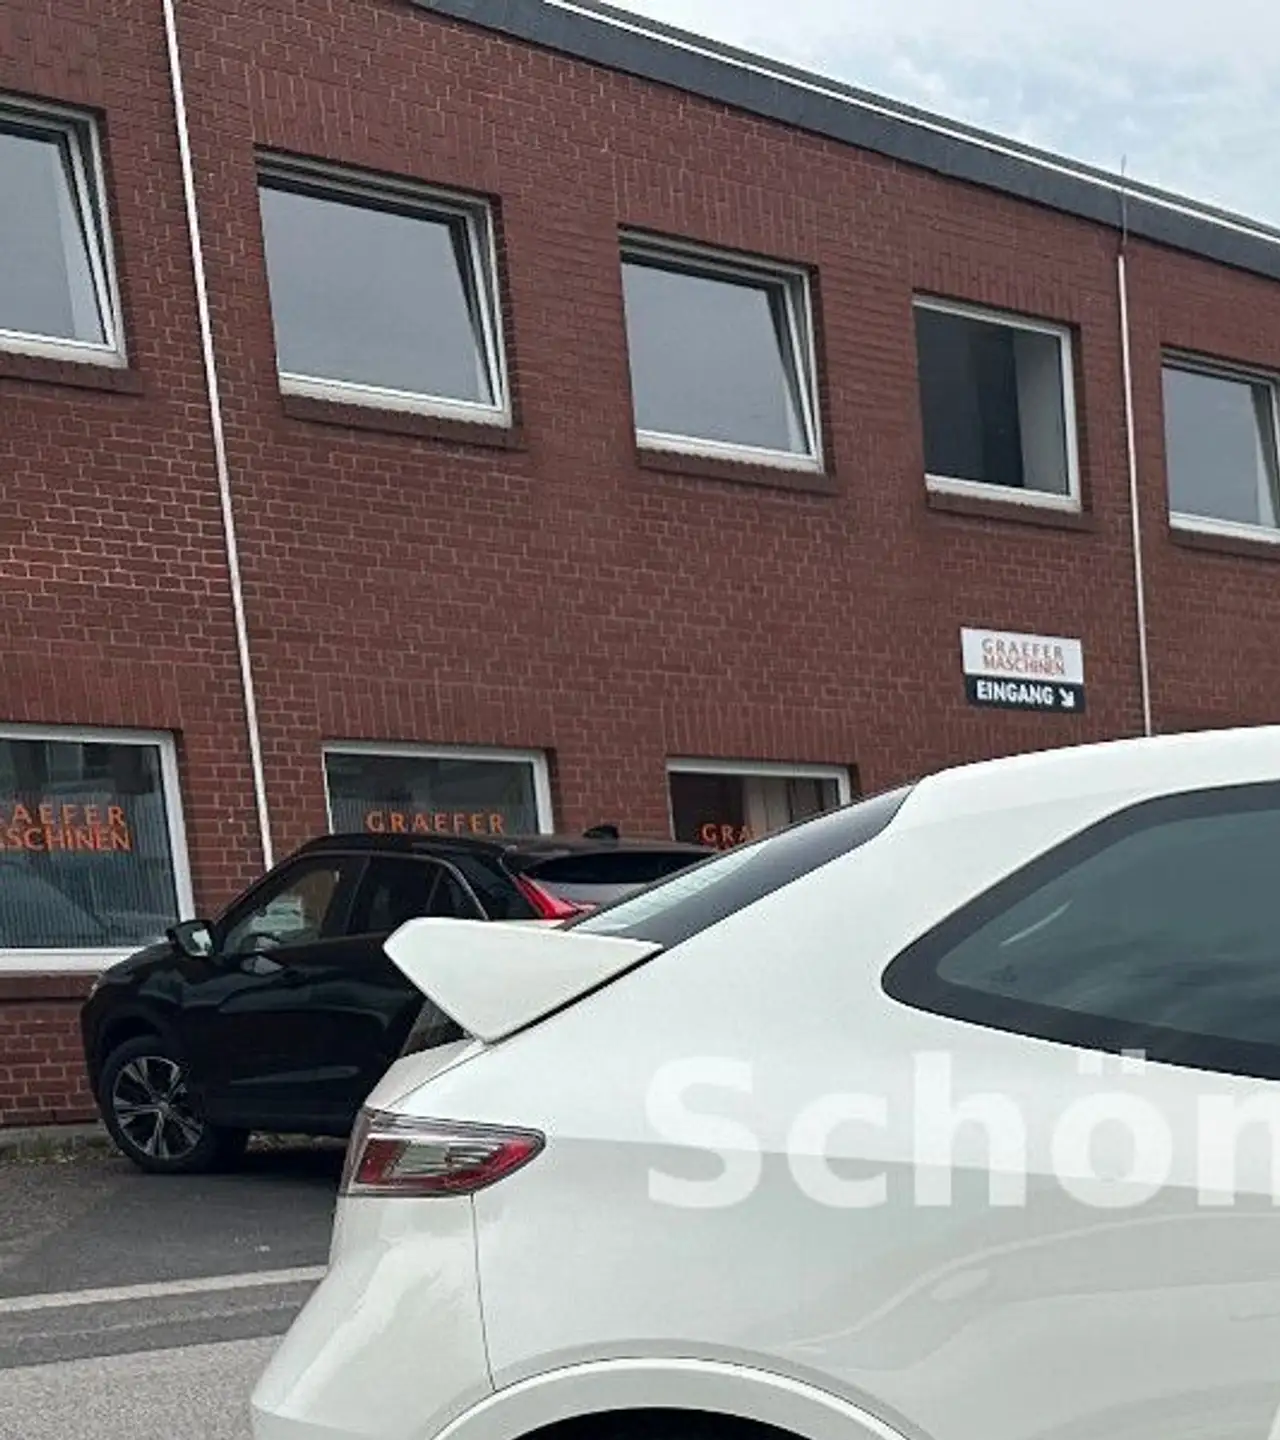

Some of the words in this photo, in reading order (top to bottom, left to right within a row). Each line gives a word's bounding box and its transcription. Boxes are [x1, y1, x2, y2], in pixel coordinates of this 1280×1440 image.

[981, 638, 1063, 657] GRAEFER
[983, 655, 1066, 676] MASCHINEN
[976, 680, 1054, 705] EINGANG
[0, 803, 126, 826] AEFER
[365, 810, 504, 835] GRAEFER
